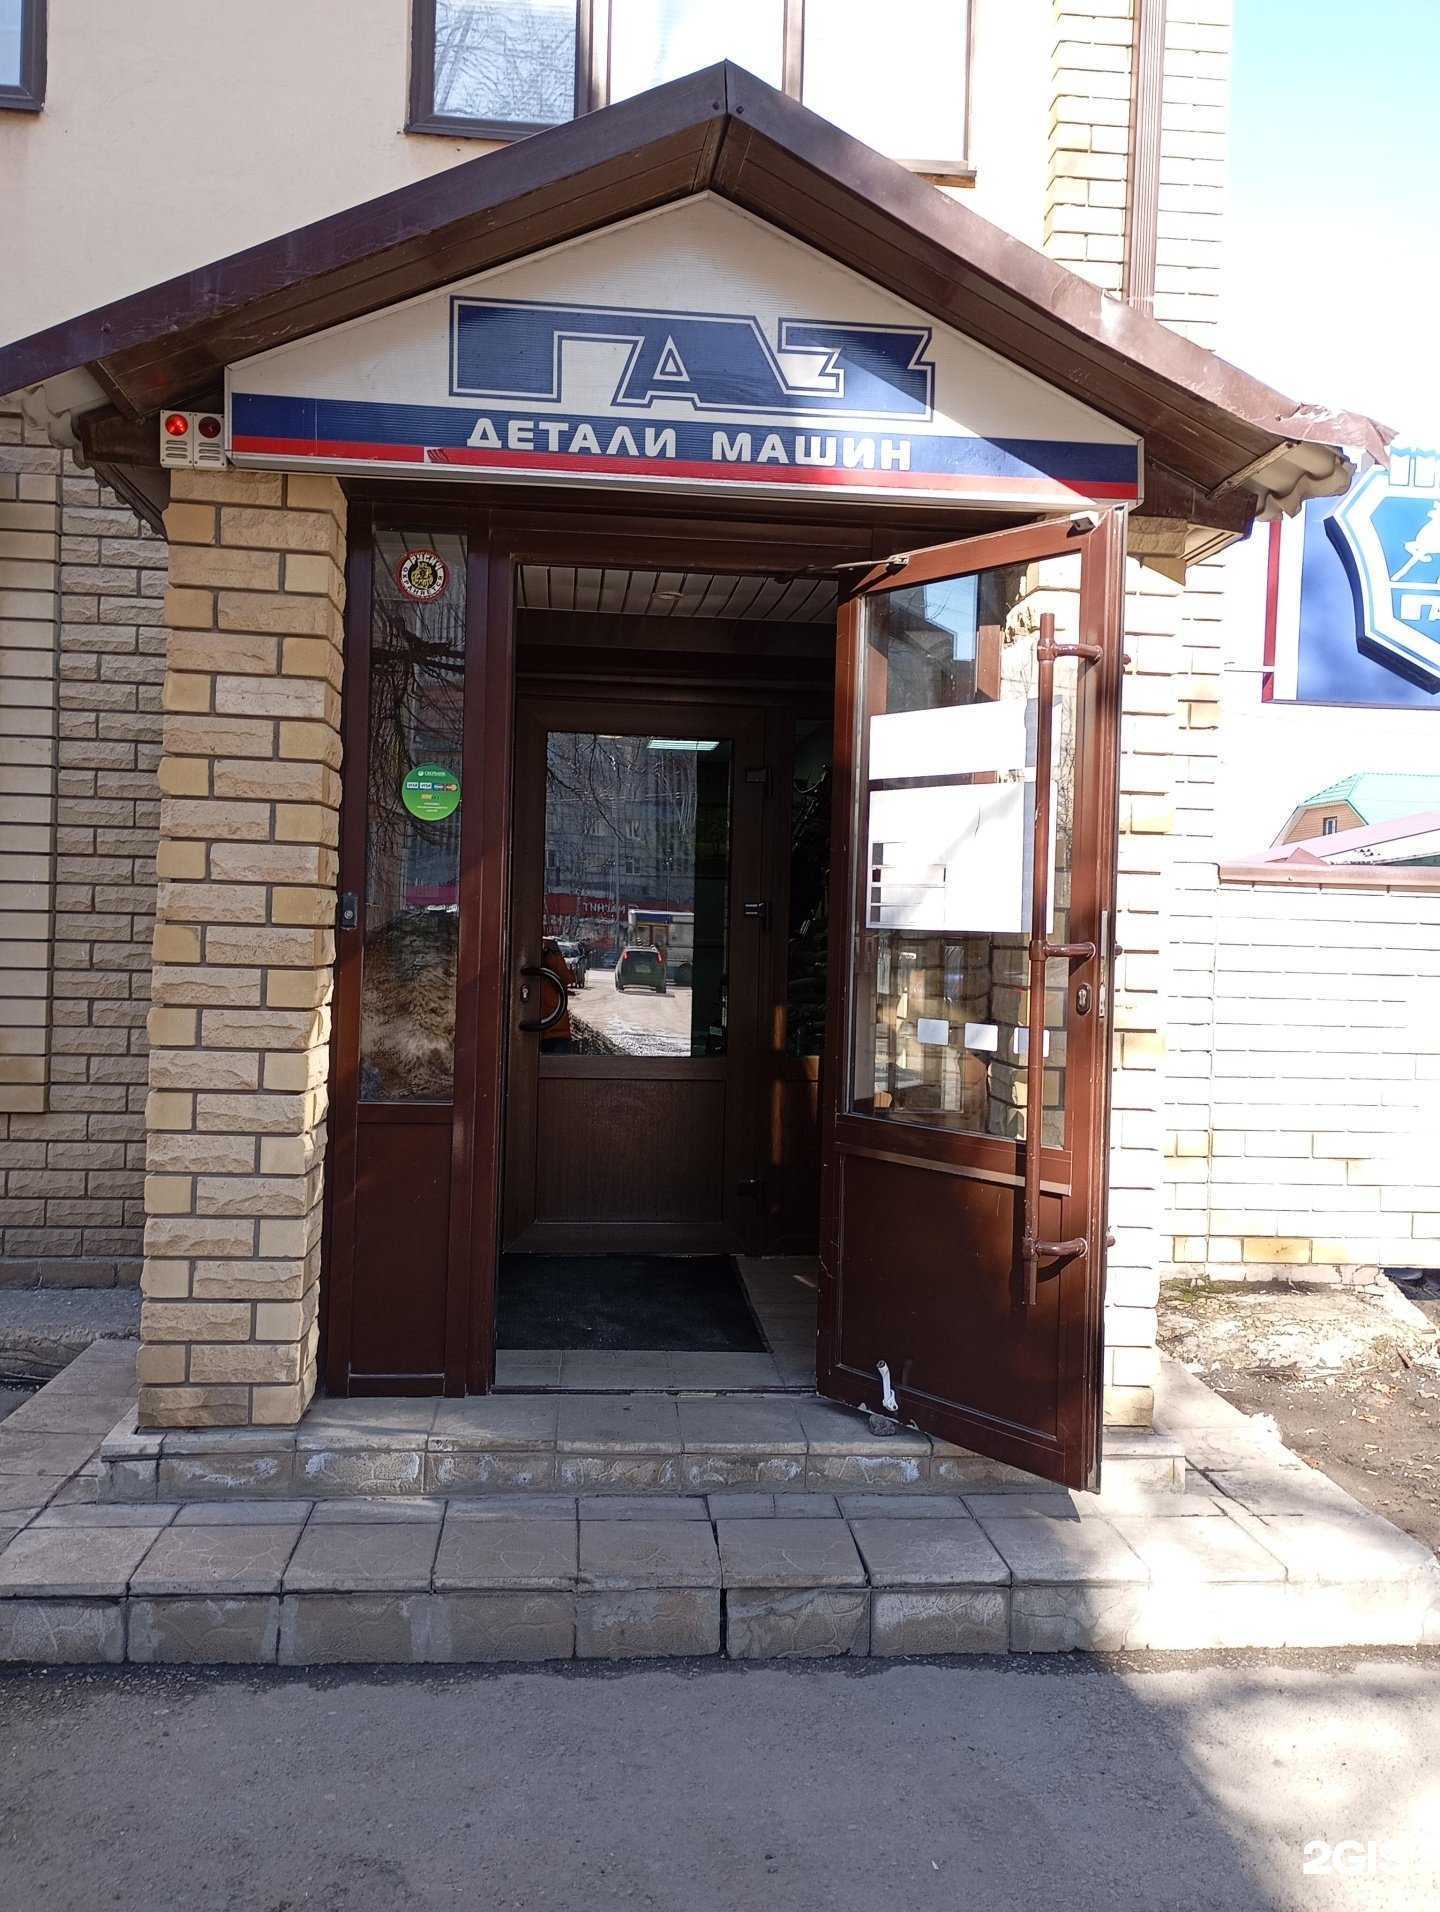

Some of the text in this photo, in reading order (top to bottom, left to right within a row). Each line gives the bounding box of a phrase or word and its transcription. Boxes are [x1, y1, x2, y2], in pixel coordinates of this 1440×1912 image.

[448, 294, 935, 423] ГАЗ
[466, 417, 912, 471] ДЕТАЛИ МАШИН
